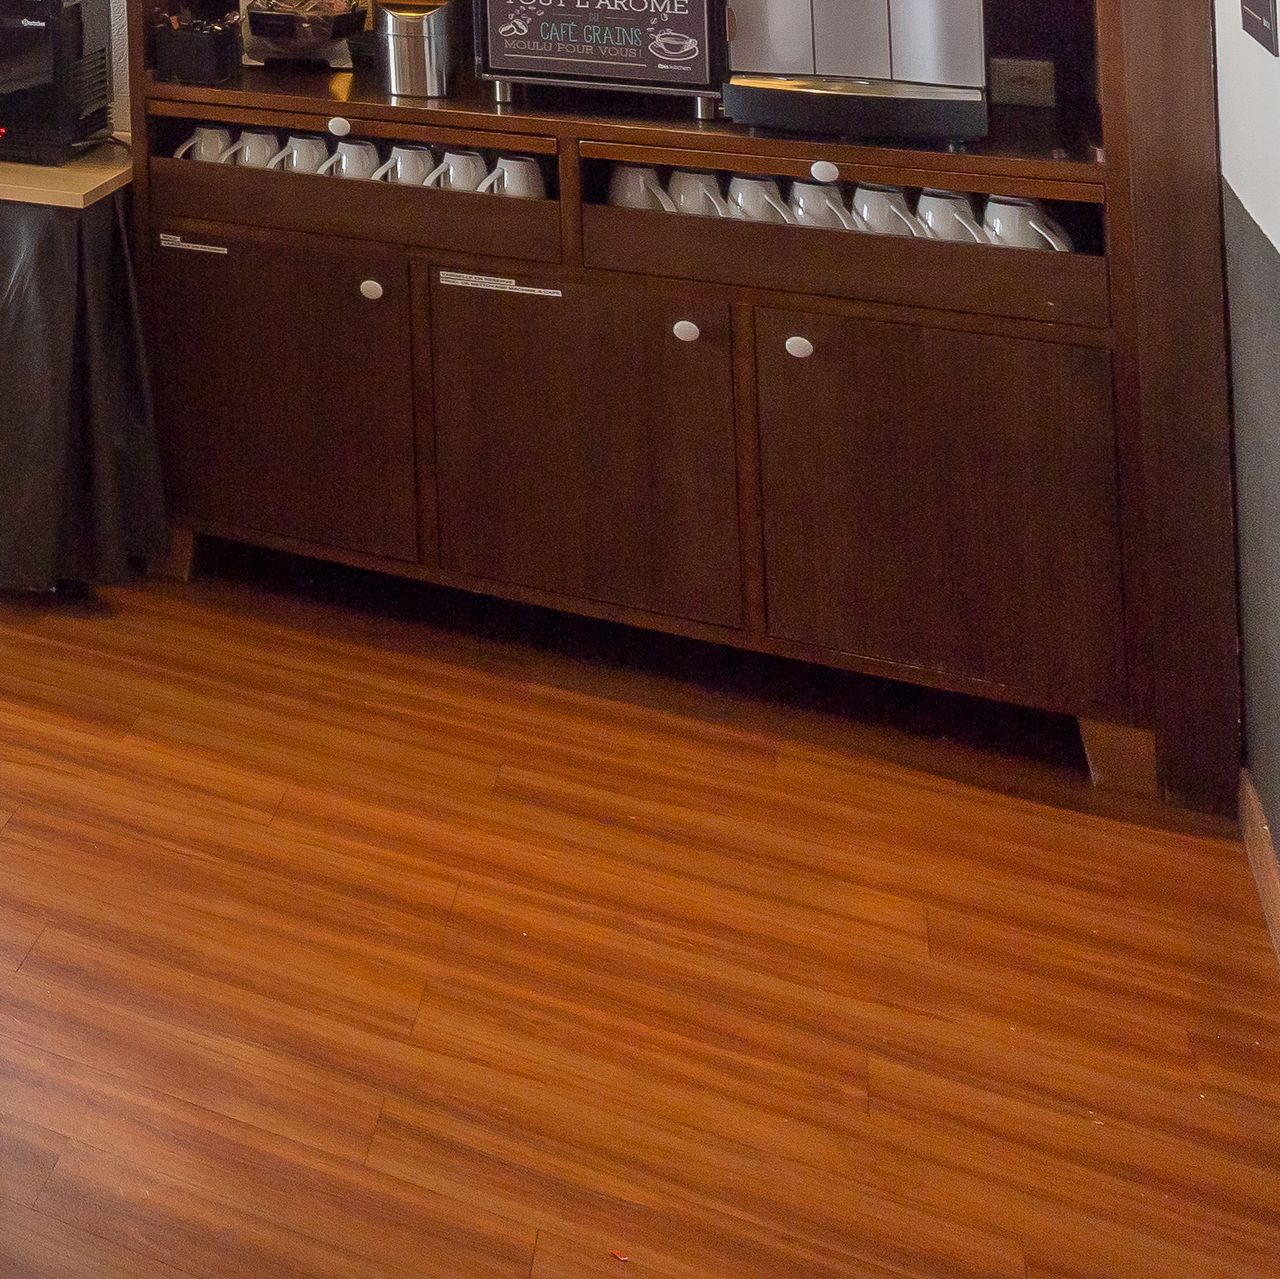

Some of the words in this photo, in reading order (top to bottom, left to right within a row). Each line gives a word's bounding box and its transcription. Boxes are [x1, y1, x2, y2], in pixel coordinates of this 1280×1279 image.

[540, 21, 577, 42] CAFÉ
[583, 24, 642, 47] GRAINS
[504, 39, 553, 52] MOULU
[557, 43, 594, 54] POUR
